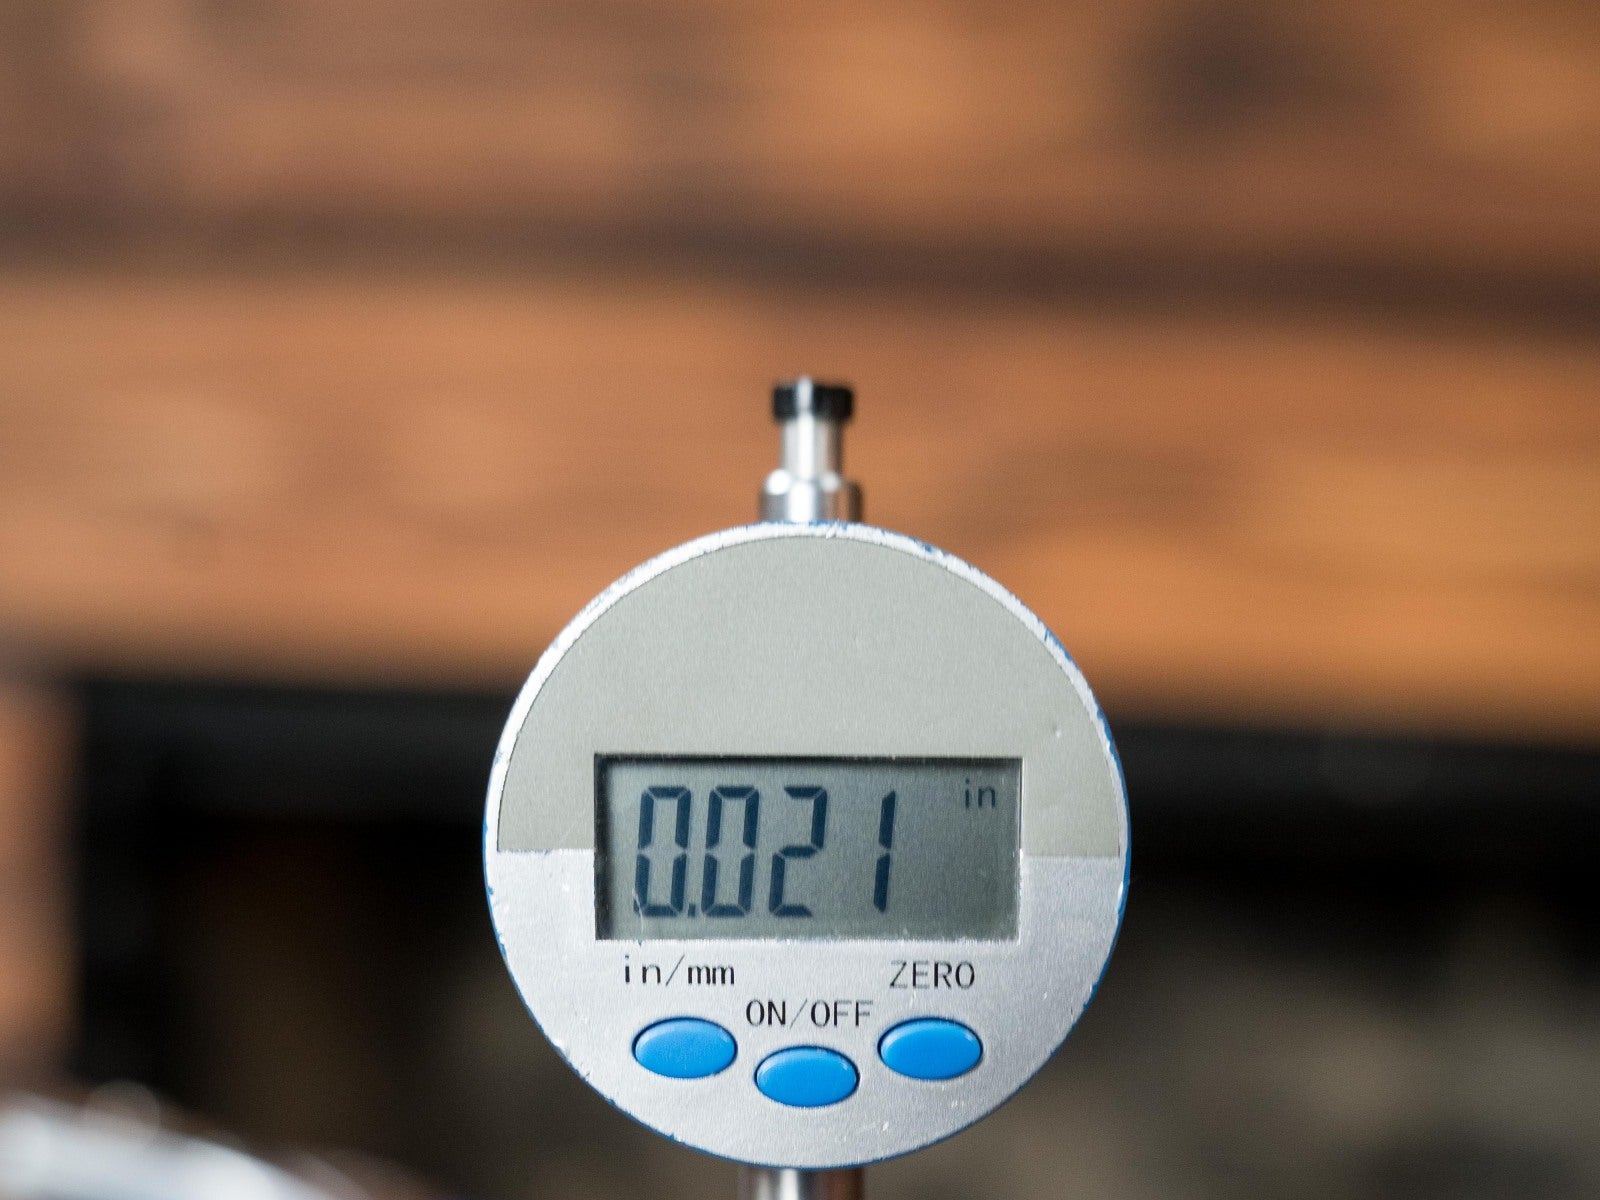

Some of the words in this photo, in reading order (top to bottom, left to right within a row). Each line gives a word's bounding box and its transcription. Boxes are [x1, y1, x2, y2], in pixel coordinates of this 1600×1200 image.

[964, 778, 996, 809] in
[633, 785, 896, 918] 0.021
[623, 954, 736, 986] in/mm
[889, 960, 976, 990] ZERO
[745, 999, 874, 1027] ON/OFF
